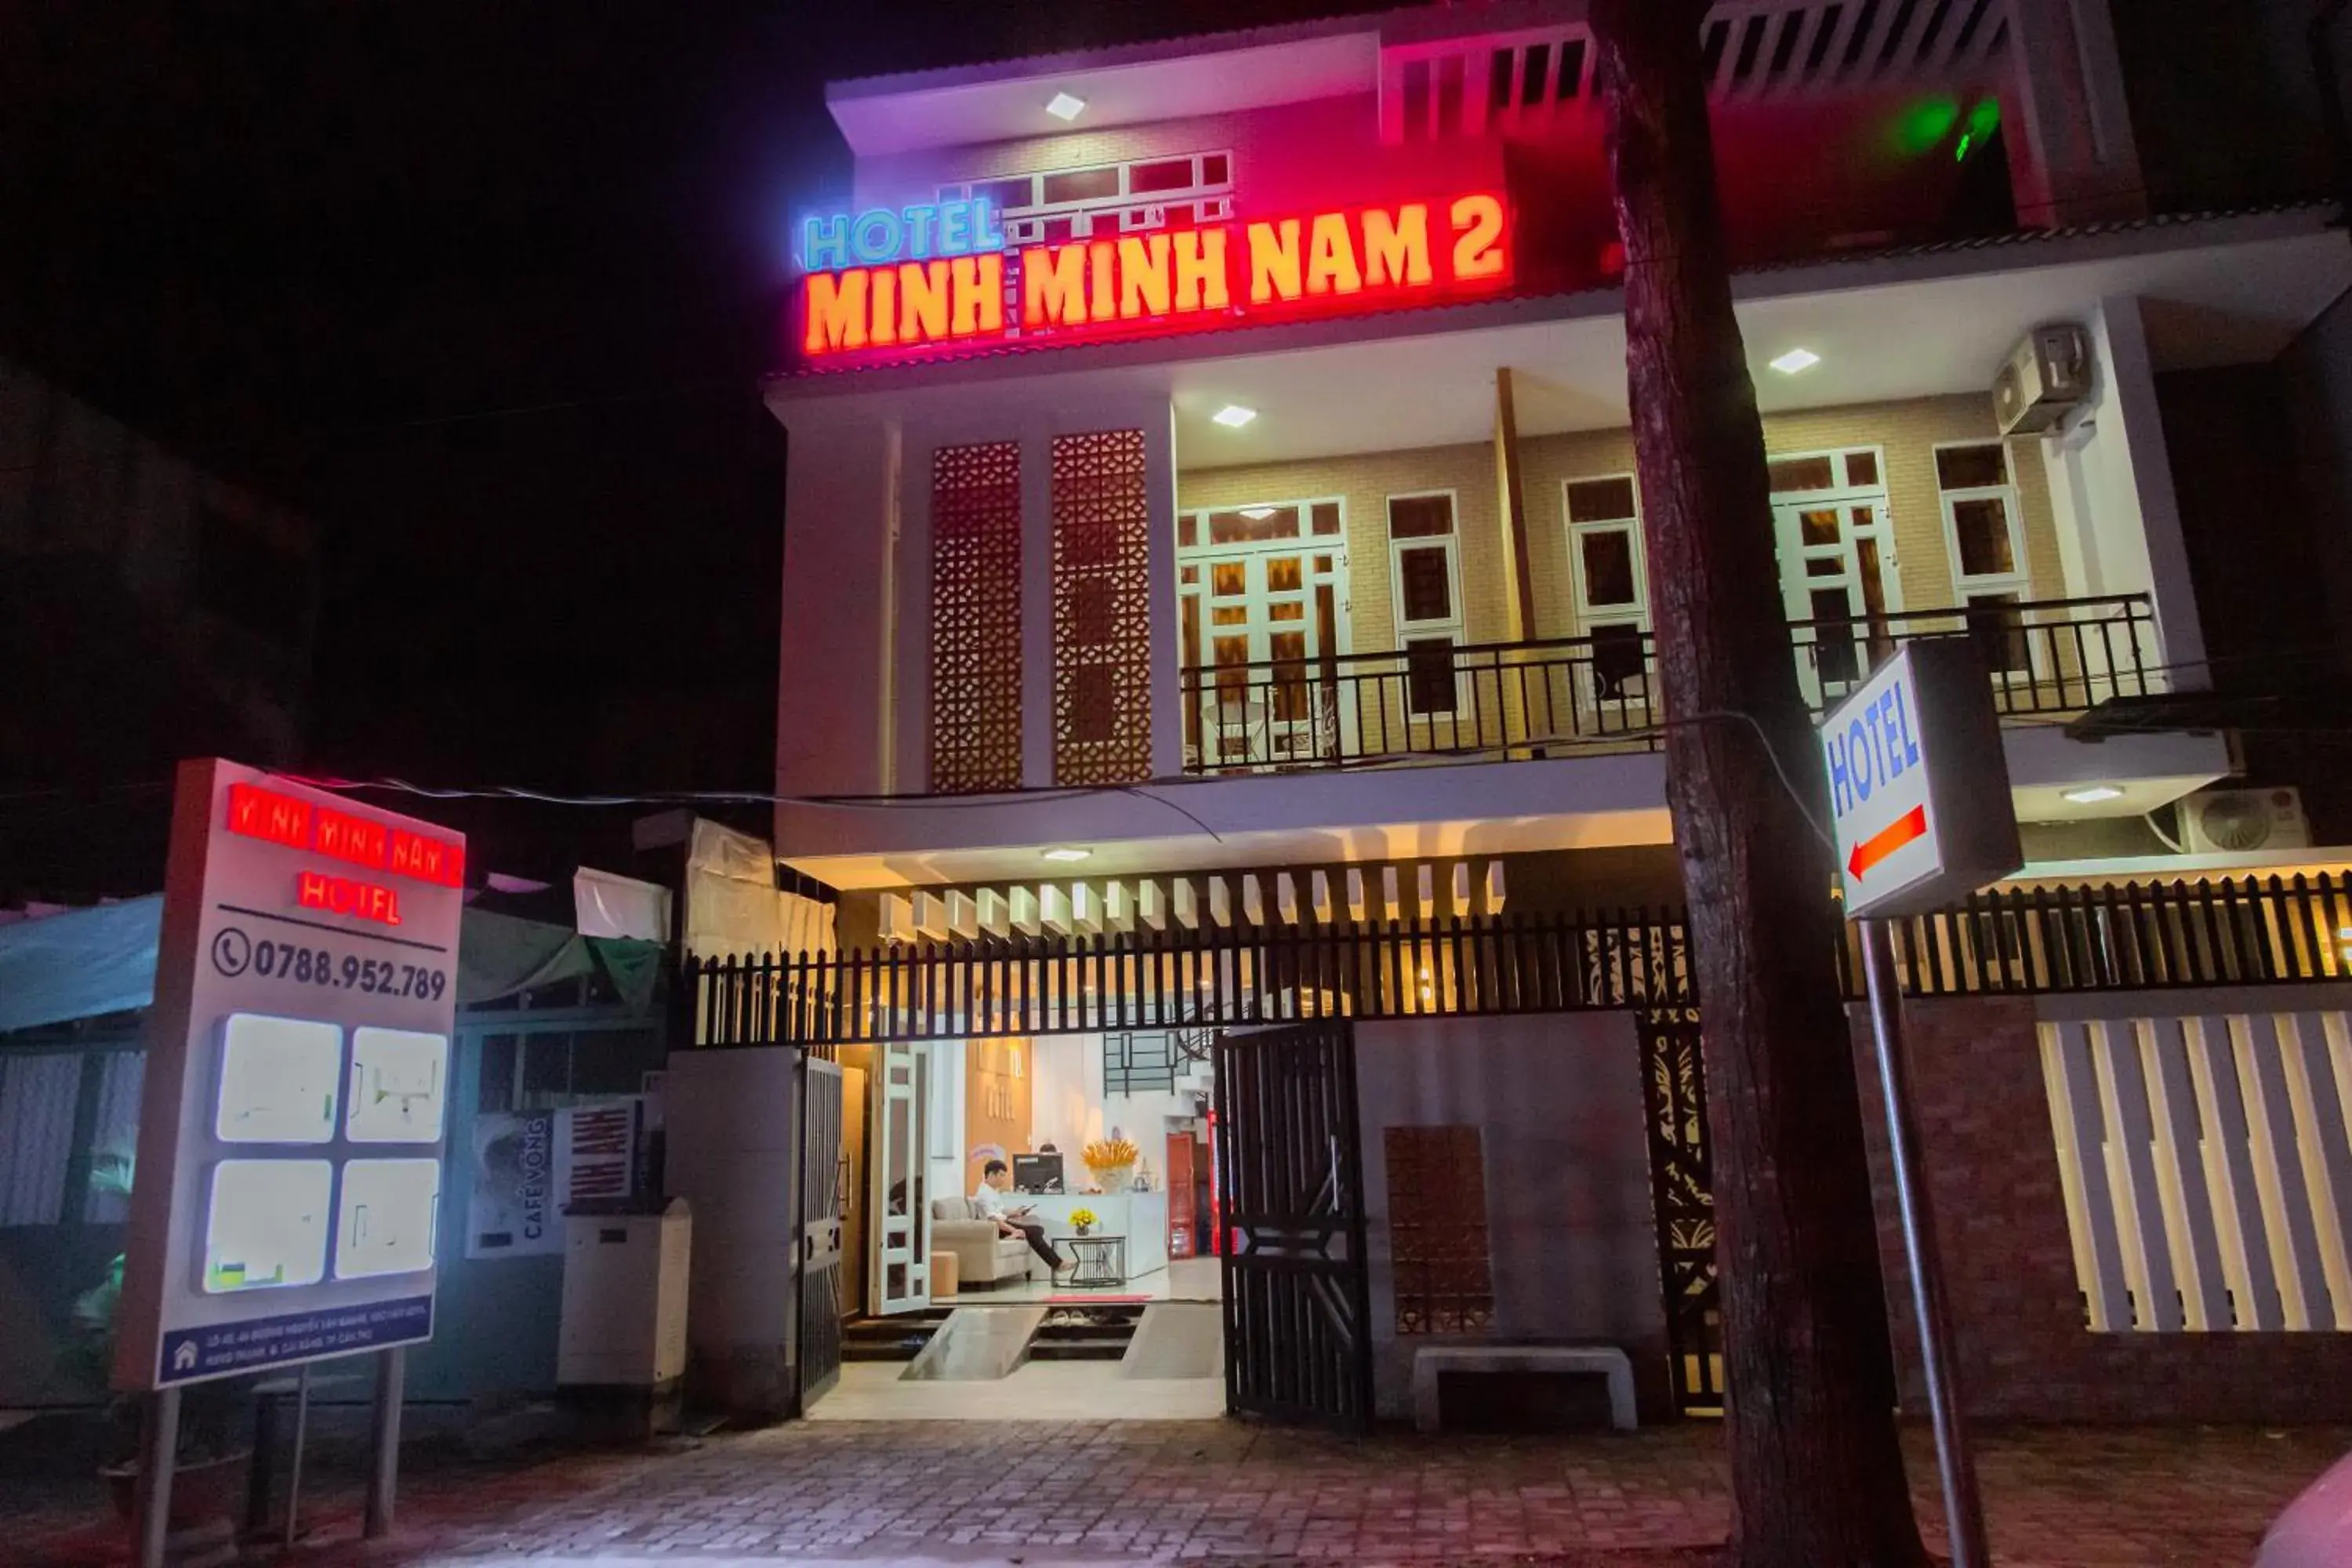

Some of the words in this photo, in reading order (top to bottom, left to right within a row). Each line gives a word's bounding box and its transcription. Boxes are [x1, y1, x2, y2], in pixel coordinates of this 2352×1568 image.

[805, 196, 1005, 270] HOTEL
[804, 254, 1004, 354] MINH
[1022, 226, 1229, 329] MINH
[1248, 203, 1429, 305] NAM
[1450, 194, 1504, 279] 2
[1828, 681, 1919, 818] HOTEL
[301, 872, 401, 924] HOTEL
[255, 940, 446, 1001] 0788.952.789
